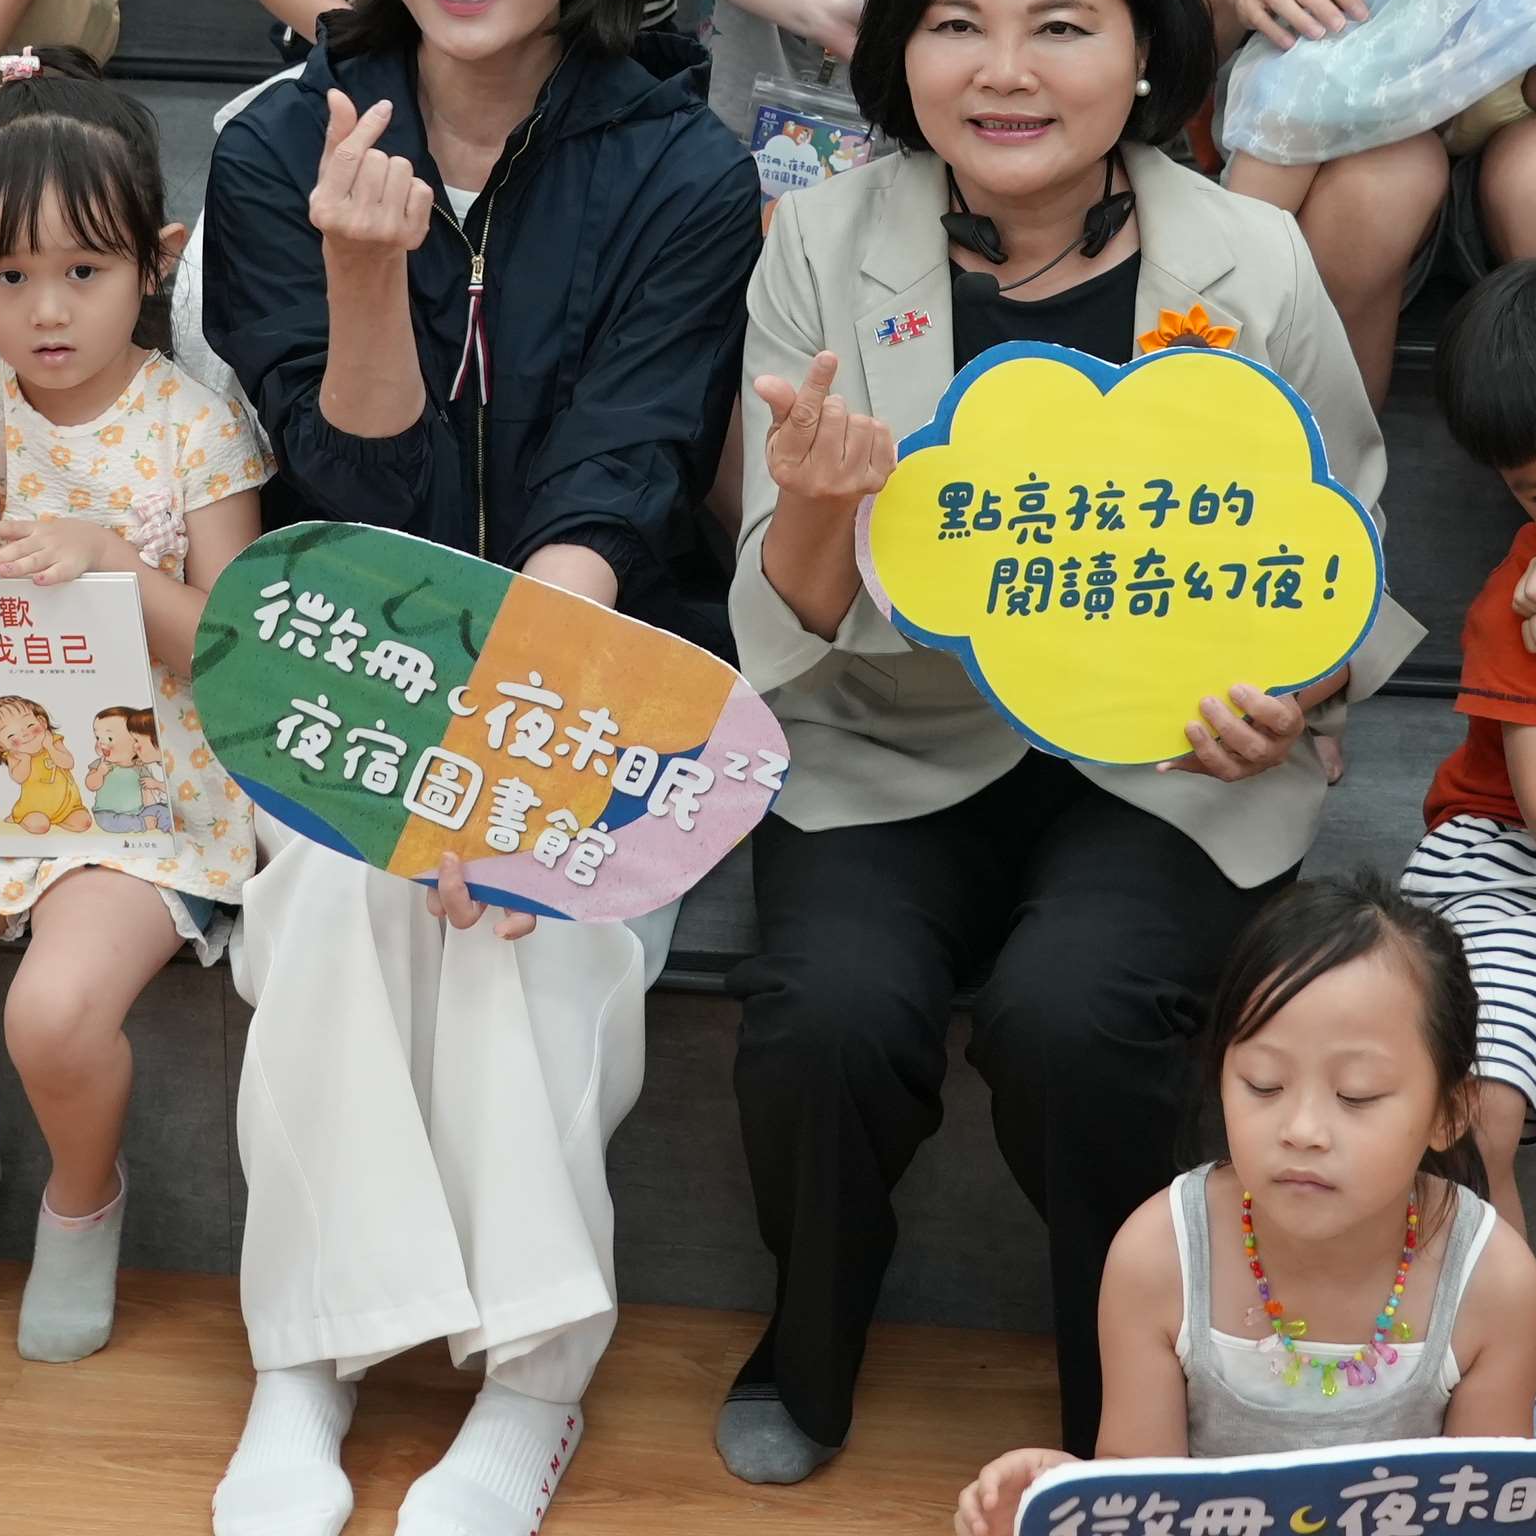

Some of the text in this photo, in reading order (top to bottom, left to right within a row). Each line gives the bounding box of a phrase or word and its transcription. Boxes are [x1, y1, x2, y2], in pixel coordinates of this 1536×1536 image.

[937, 471, 1255, 545] 點亮孩子的
[276, 694, 617, 887] 夜宿圖書館
